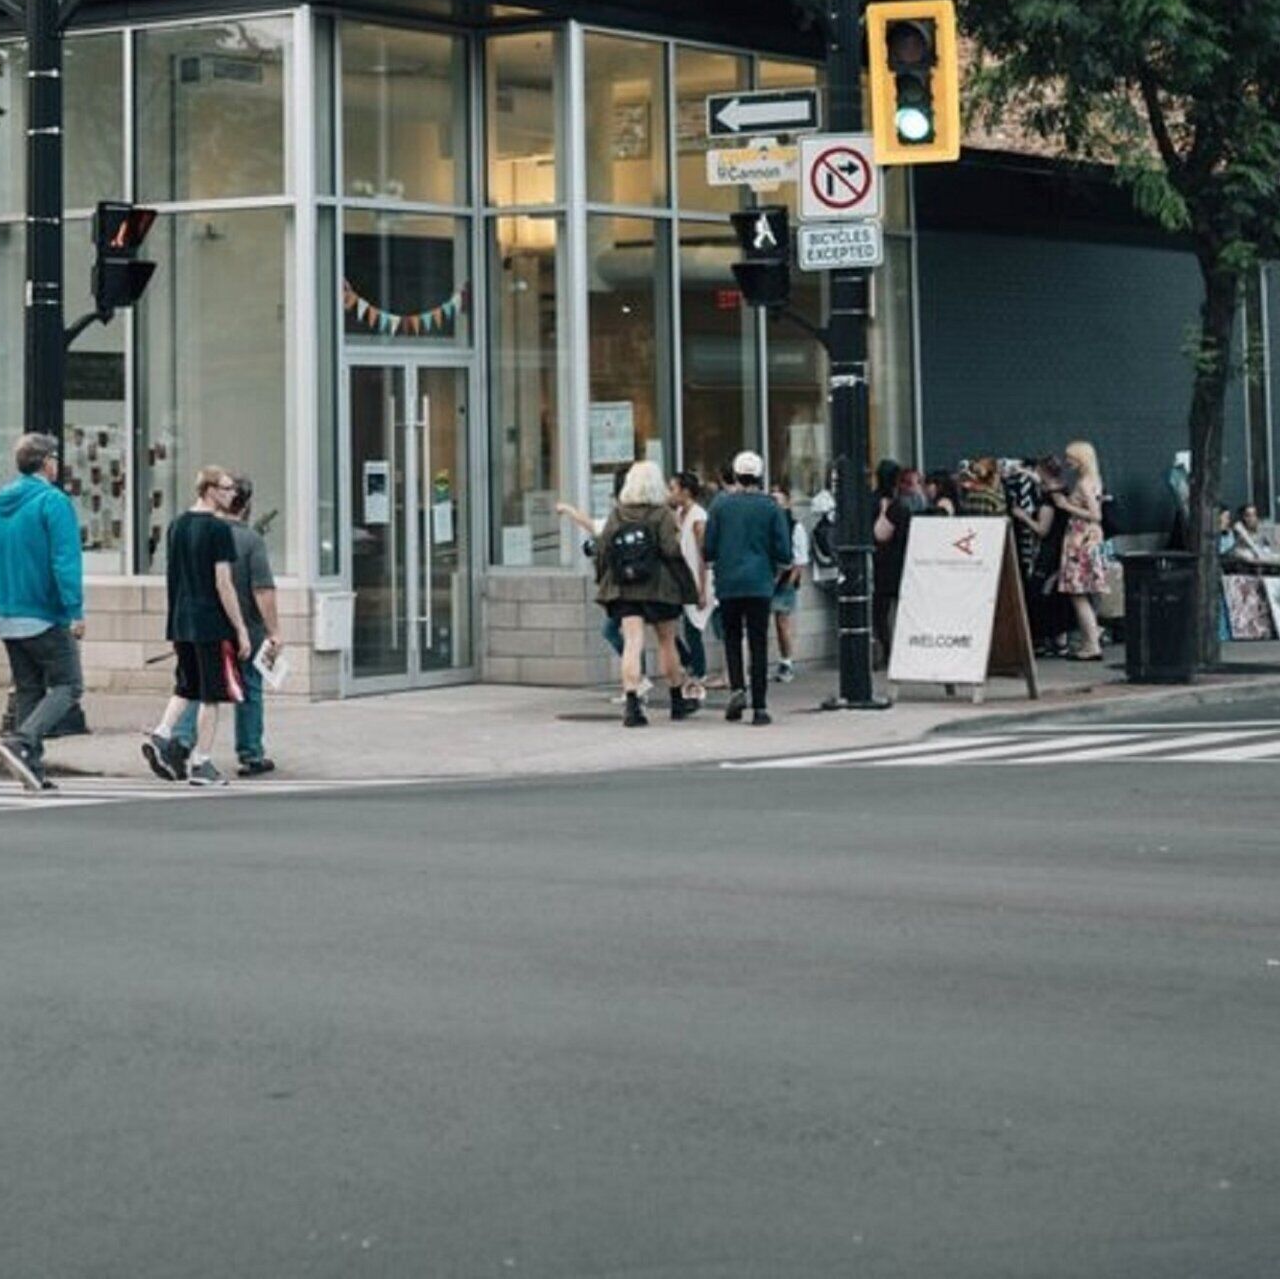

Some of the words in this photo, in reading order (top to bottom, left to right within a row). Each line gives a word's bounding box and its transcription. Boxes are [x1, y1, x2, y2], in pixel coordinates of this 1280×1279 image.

[809, 229, 871, 245] BICYCLES
[807, 244, 875, 261] EXCEPTED
[908, 632, 974, 649] WELCOME
